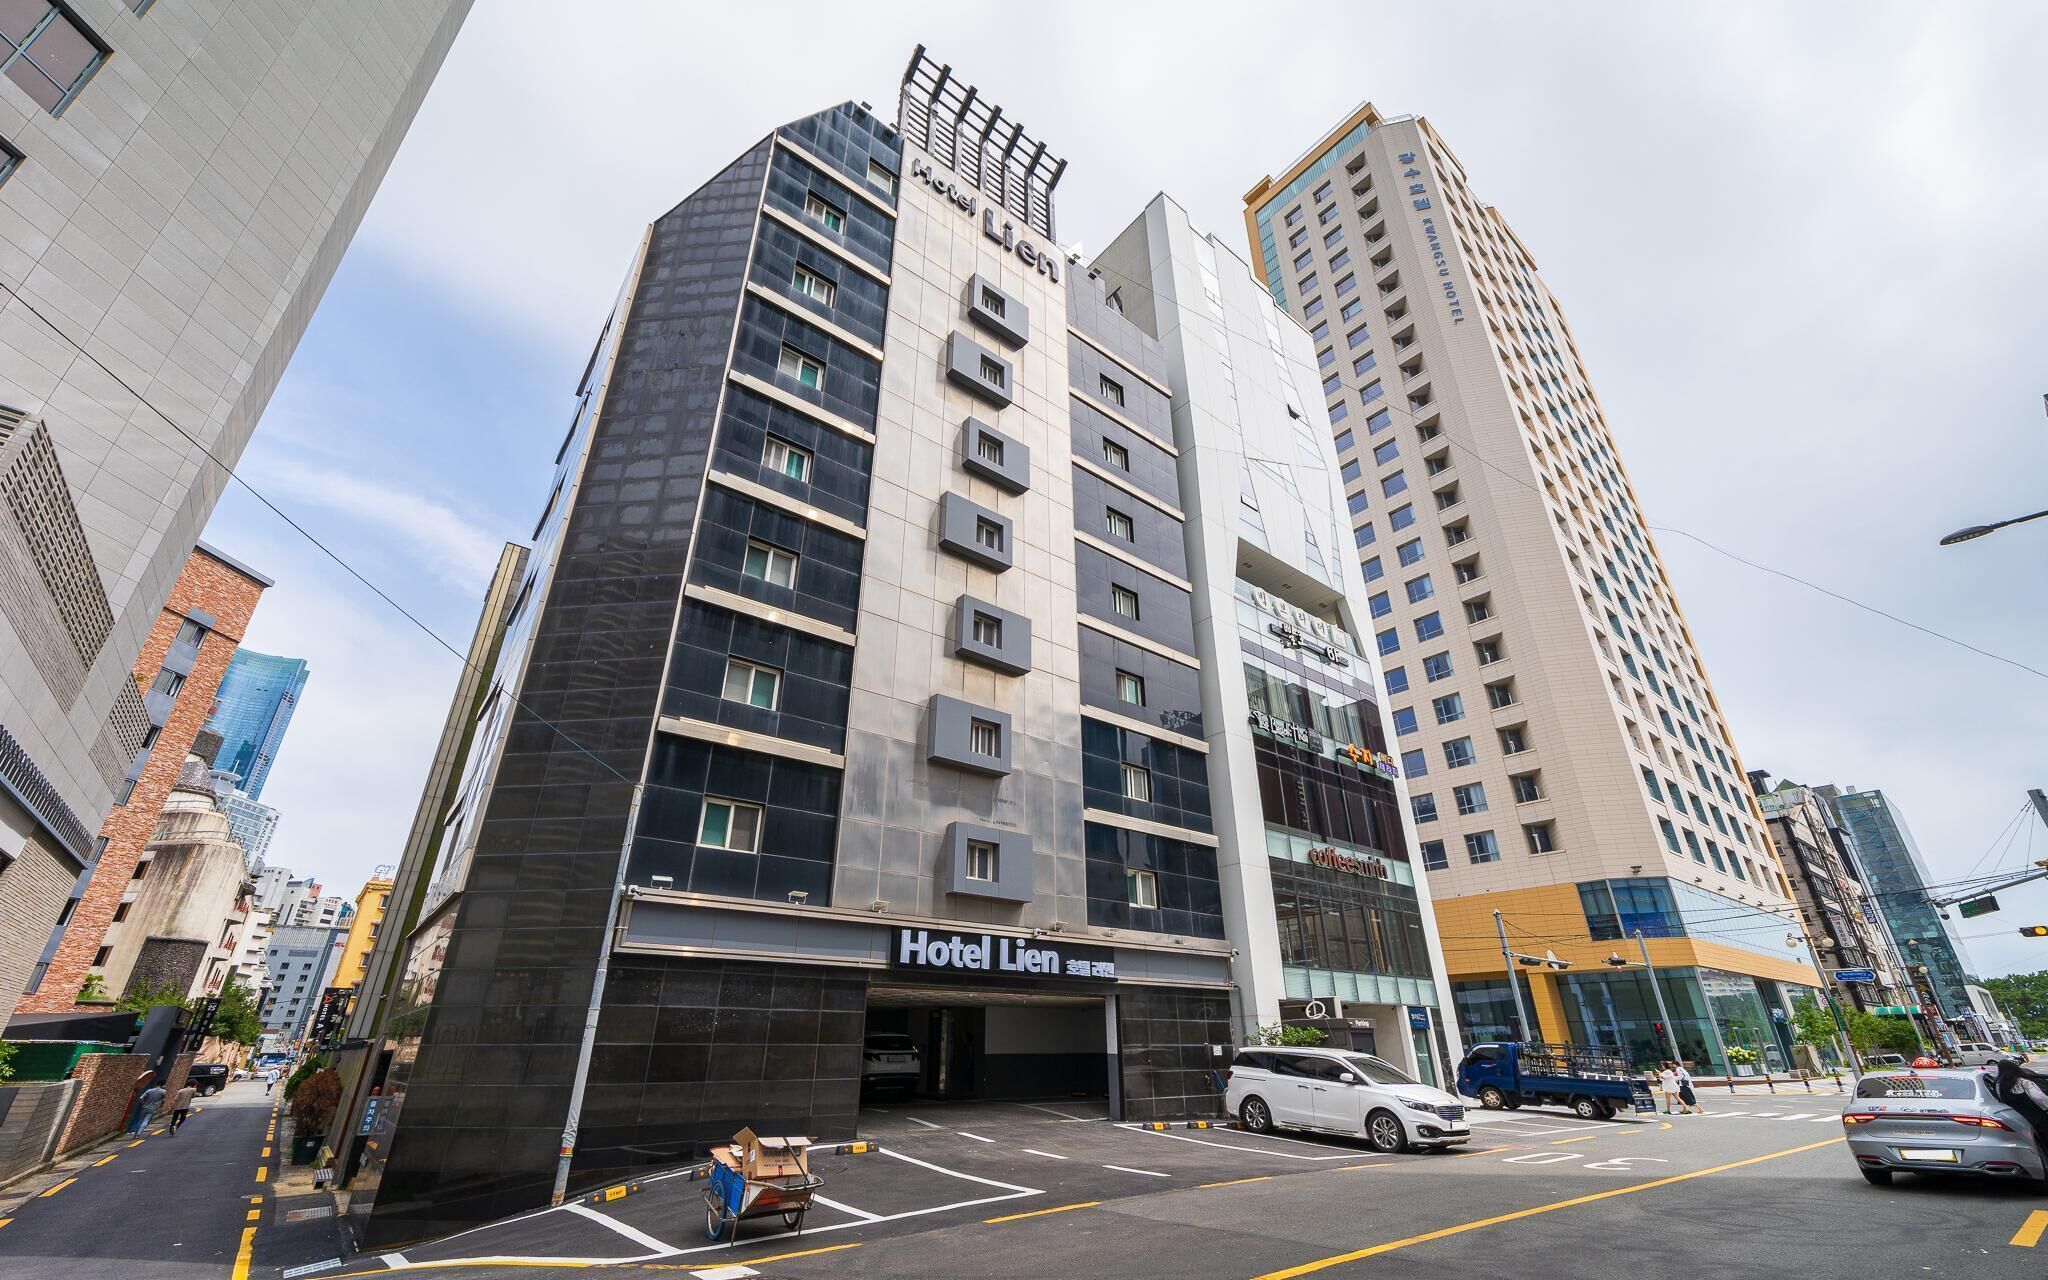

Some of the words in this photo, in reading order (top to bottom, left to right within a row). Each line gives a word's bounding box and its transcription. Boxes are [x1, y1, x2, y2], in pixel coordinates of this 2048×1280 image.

[911, 157, 977, 217] Hotel
[983, 207, 1059, 284] Lien
[1422, 217, 1450, 277] KWANGSU
[1441, 281, 1465, 326] HOTEL
[1308, 846, 1389, 879] coffeesmith
[899, 929, 991, 970] Hotel
[999, 938, 1060, 975] Lien
[1355, 1019, 1370, 1027] Parking
